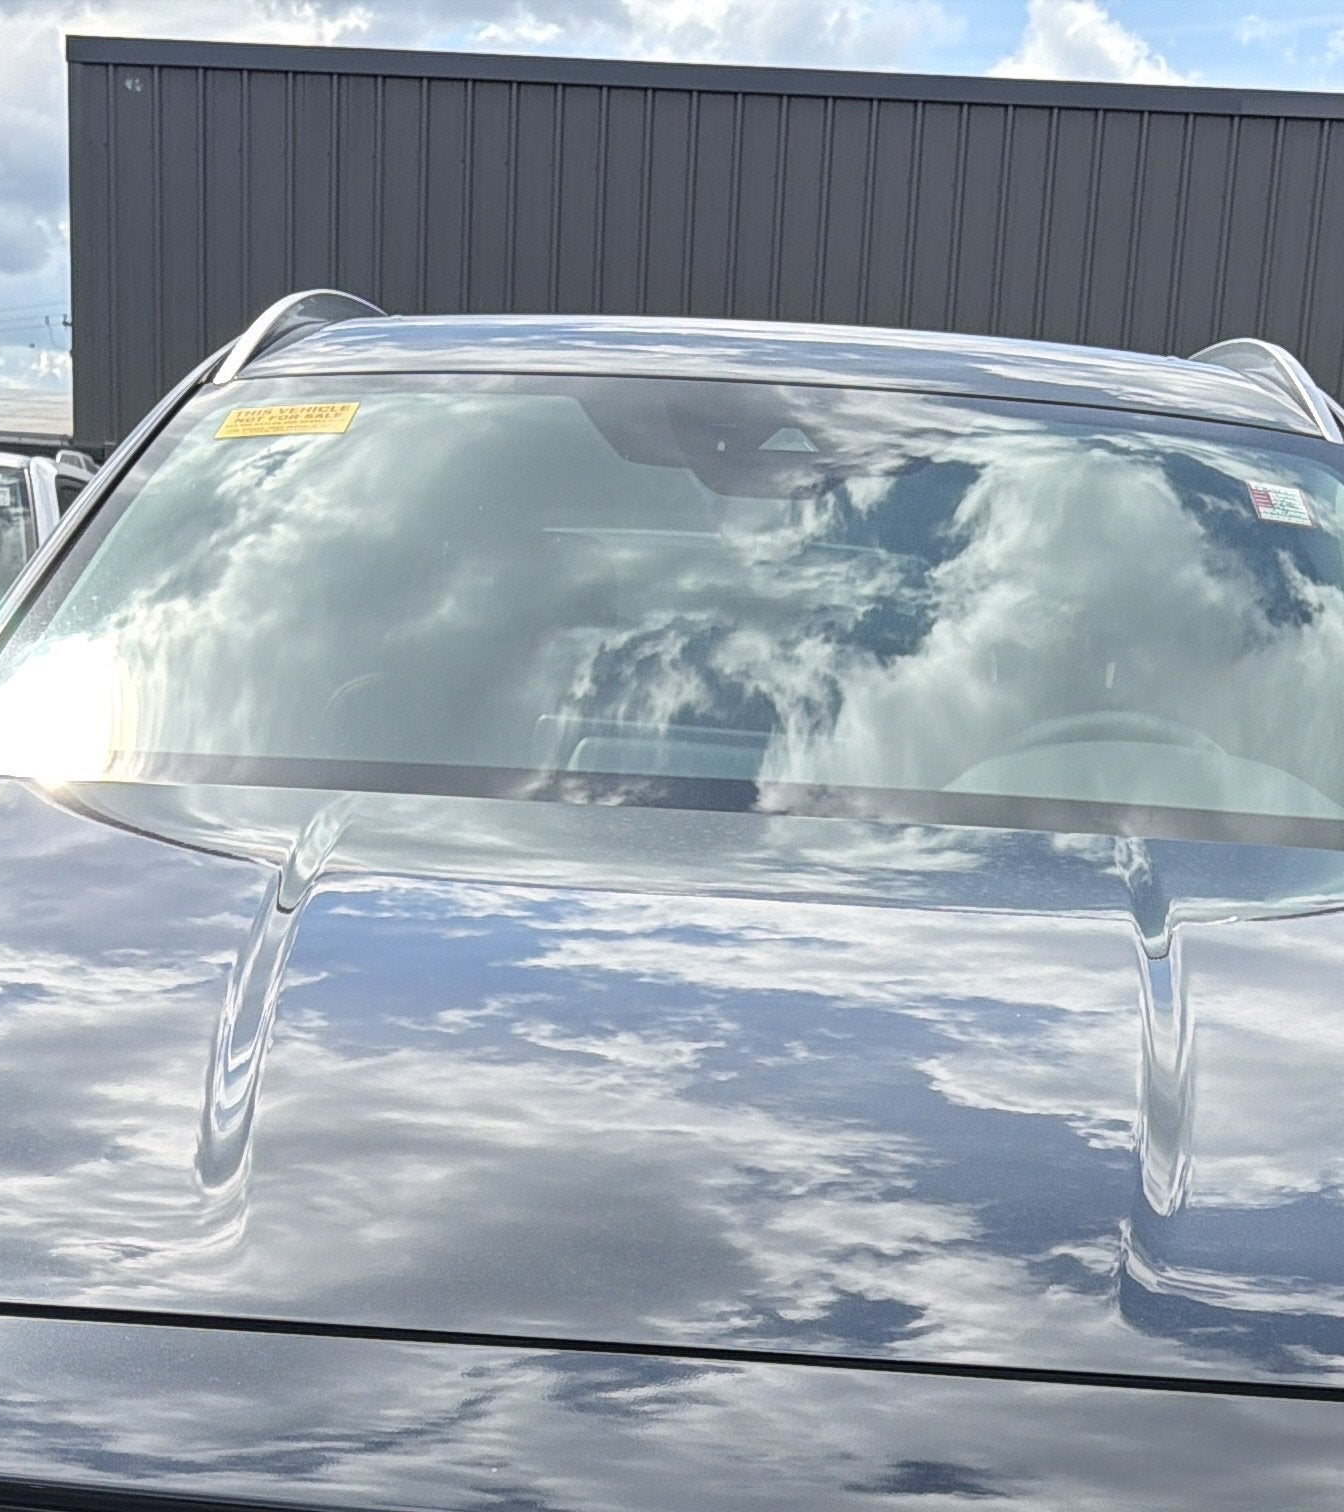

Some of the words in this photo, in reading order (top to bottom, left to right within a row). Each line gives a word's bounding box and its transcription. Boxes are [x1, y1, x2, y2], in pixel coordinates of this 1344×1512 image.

[235, 409, 273, 418] THIS
[279, 404, 352, 414] VEHICLE
[233, 416, 264, 424] NOT
[268, 413, 301, 422] FOR
